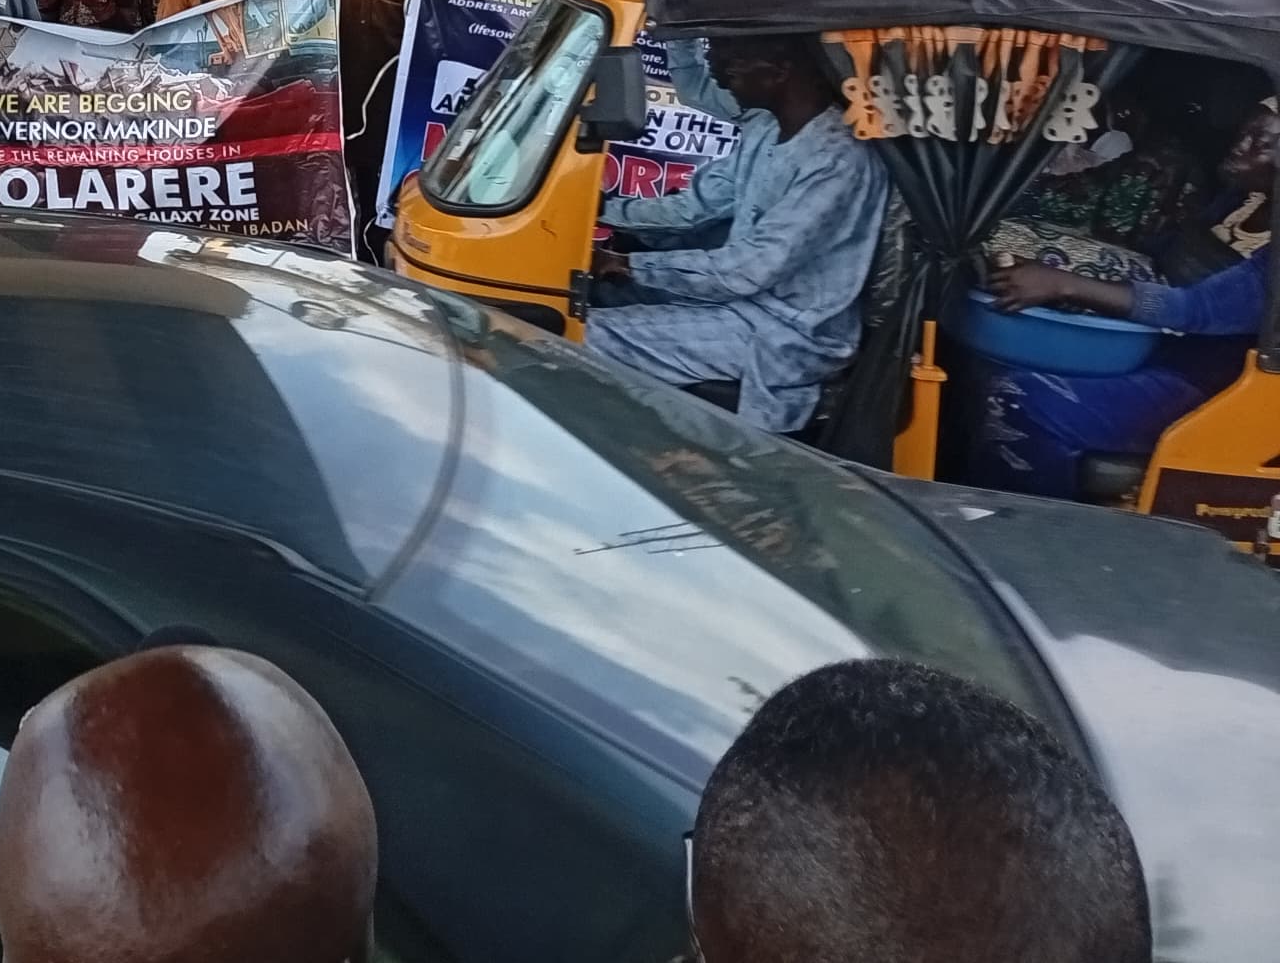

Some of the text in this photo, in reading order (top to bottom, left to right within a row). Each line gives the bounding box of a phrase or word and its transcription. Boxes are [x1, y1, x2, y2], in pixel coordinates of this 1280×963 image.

[26, 93, 70, 114] ARE
[79, 91, 192, 114] BEGGING
[103, 117, 216, 140] MAKINDE
[674, 112, 725, 135] THE
[12, 150, 40, 162] THE
[47, 148, 139, 163] REMAINING
[146, 147, 215, 161] HOUSES
[222, 145, 241, 158] IN
[665, 131, 708, 154] ON
[134, 208, 260, 223] GALAXY ZONE
[243, 219, 314, 236] IBADAN.
